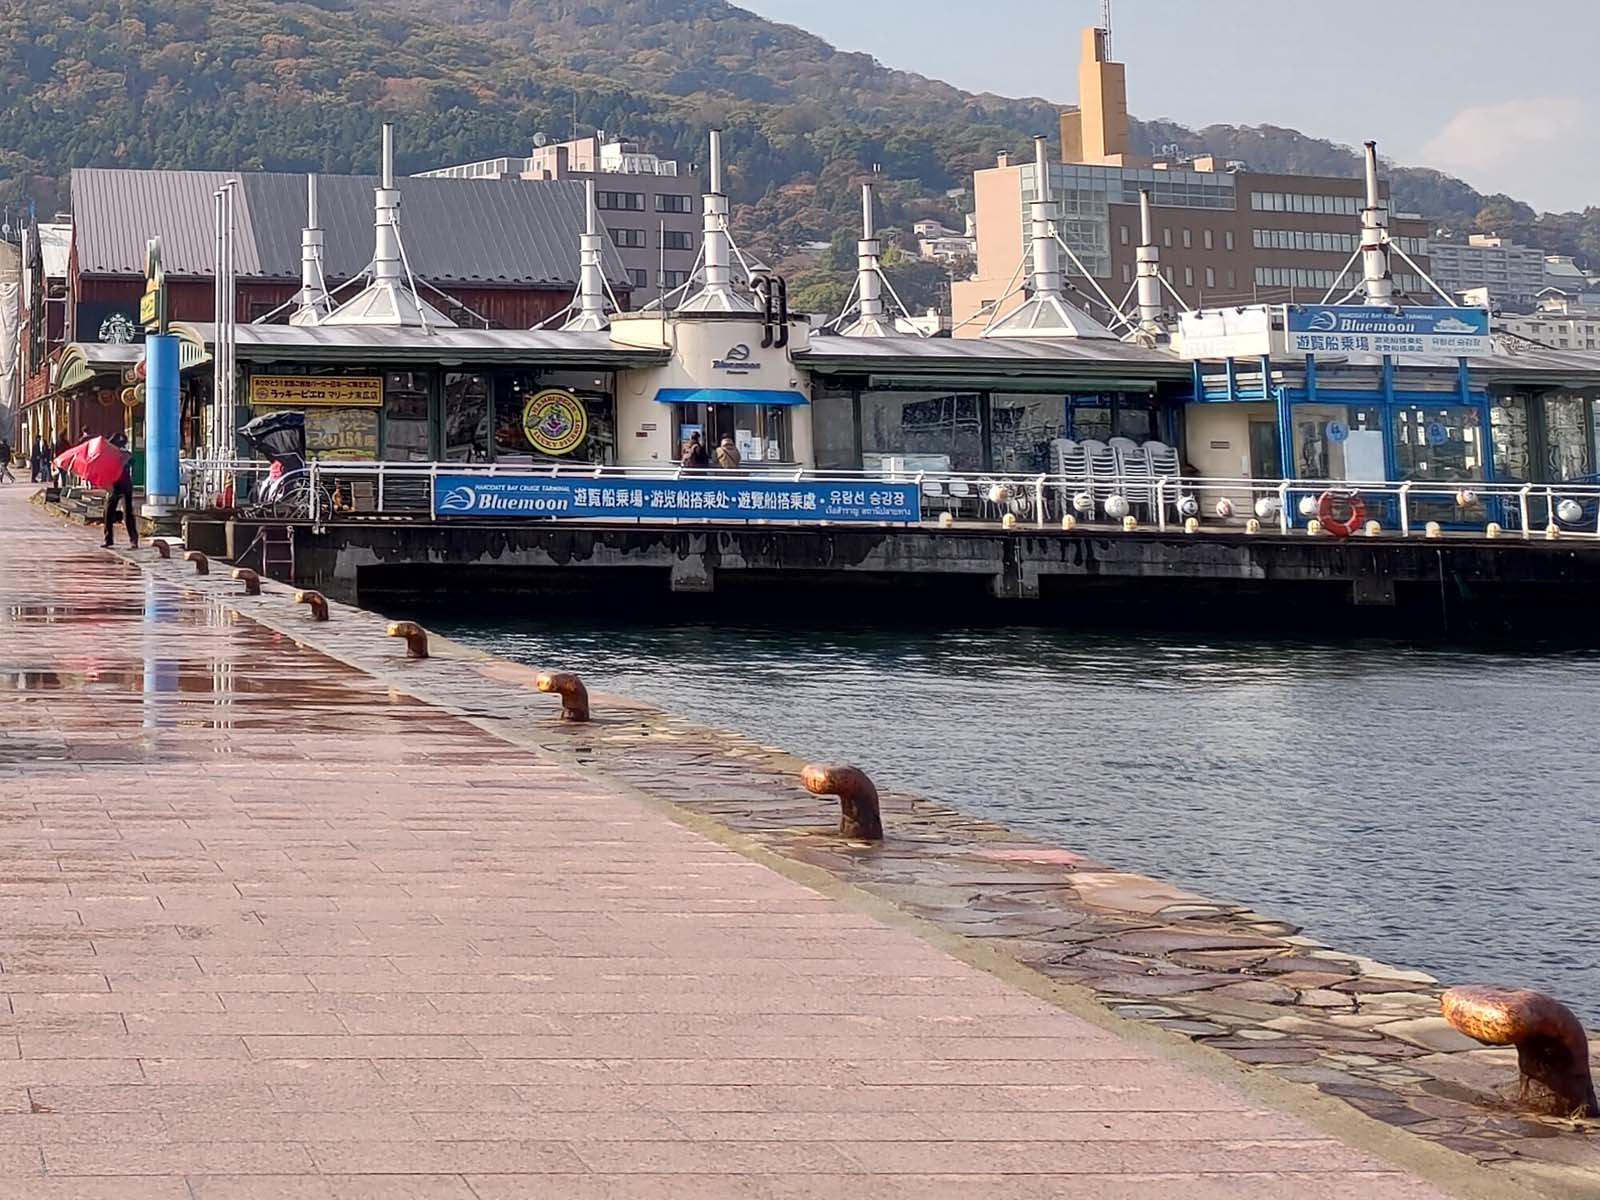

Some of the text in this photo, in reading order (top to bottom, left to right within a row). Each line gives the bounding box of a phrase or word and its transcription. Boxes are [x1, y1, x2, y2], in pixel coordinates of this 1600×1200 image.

[1341, 319, 1415, 332] Bluemoon
[1296, 335, 1369, 351] 遊覧船乗場
[479, 493, 568, 510] Bluemoon
